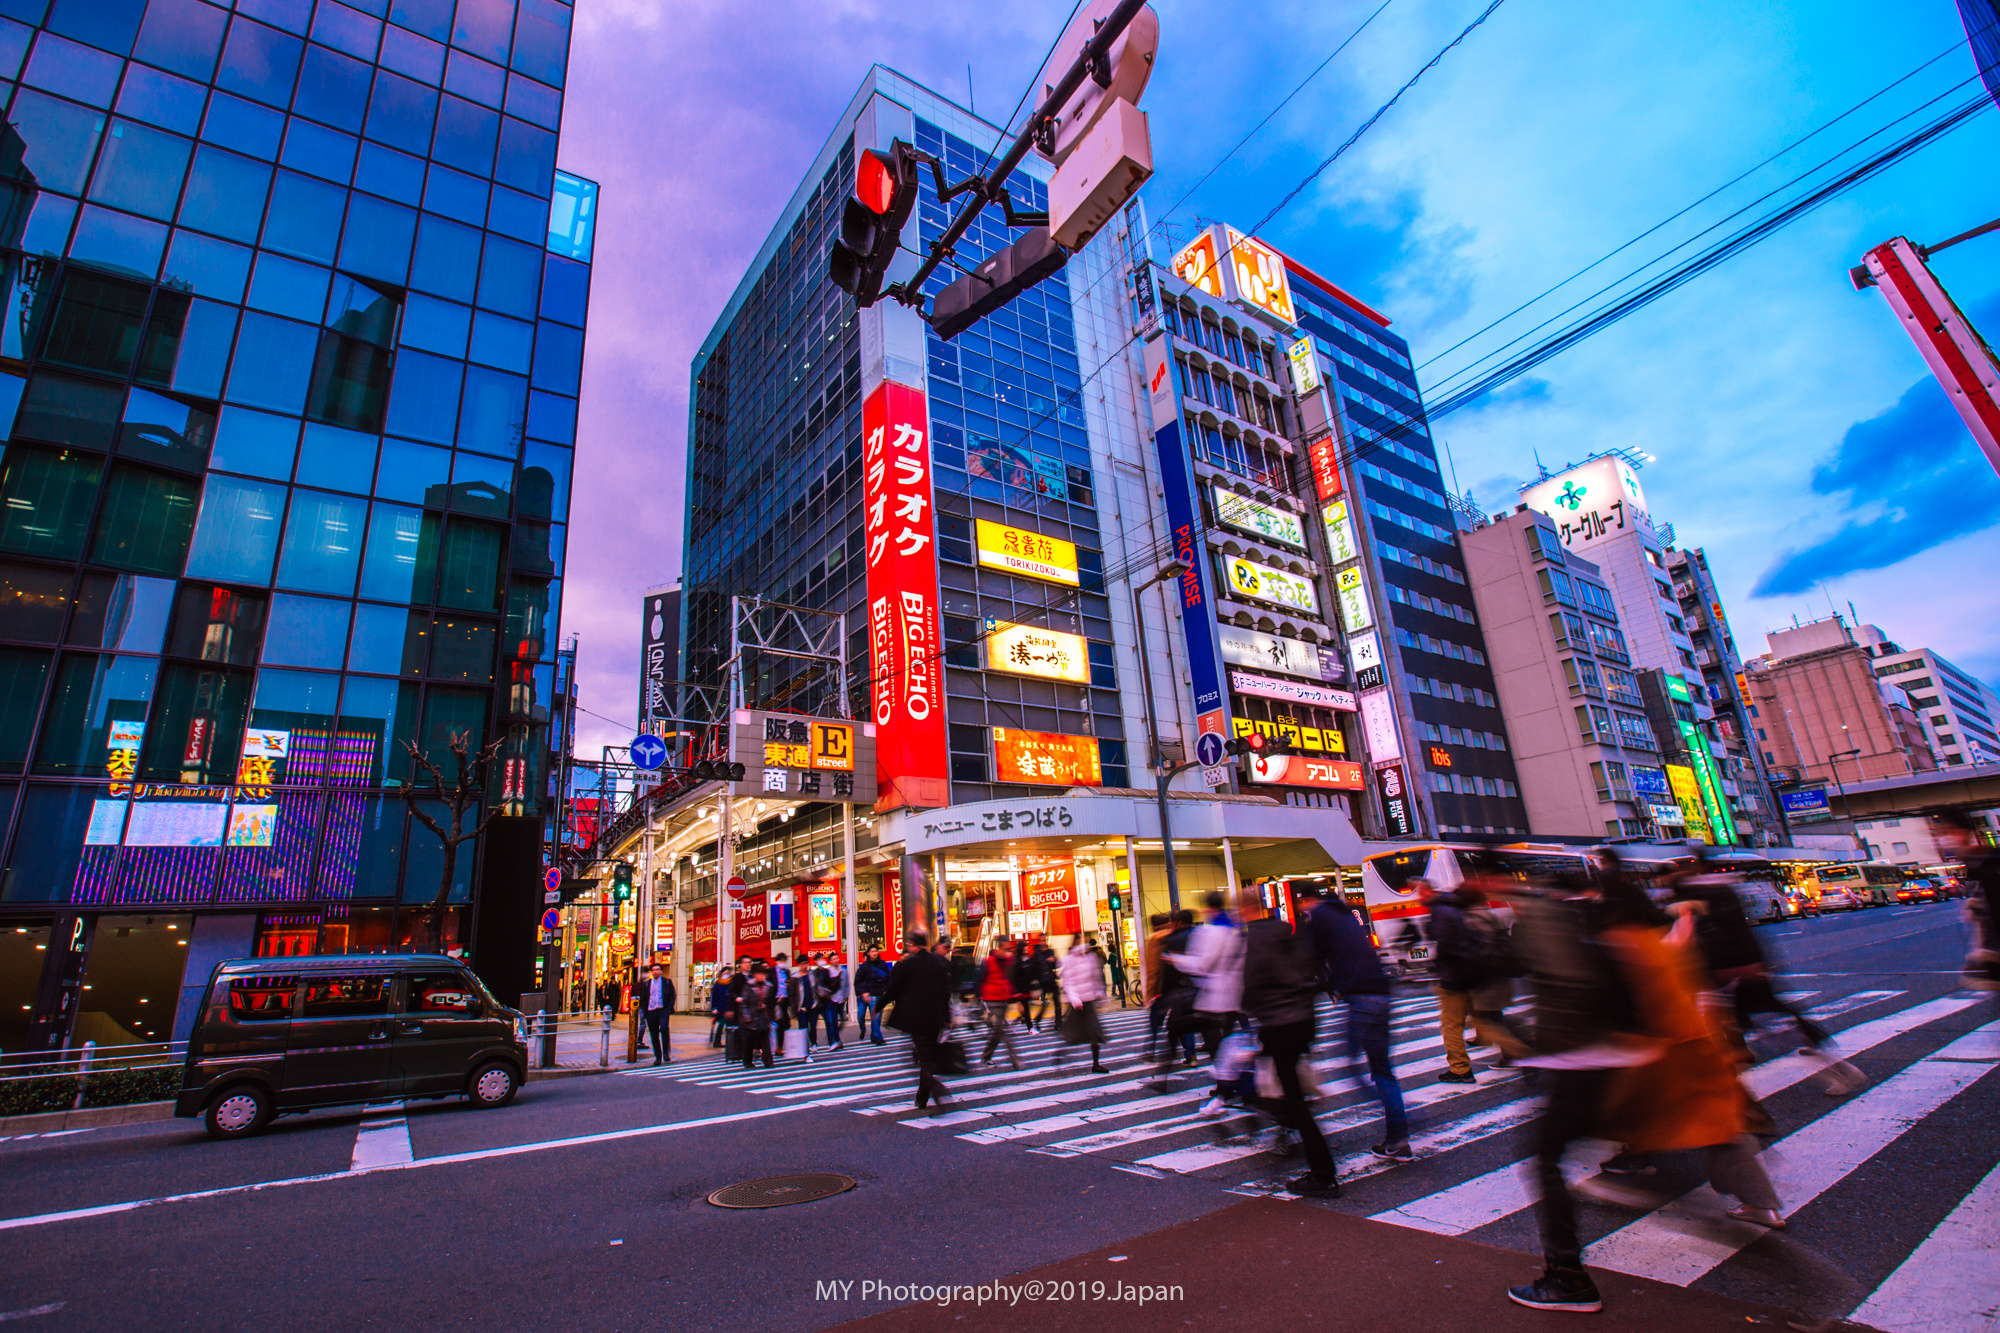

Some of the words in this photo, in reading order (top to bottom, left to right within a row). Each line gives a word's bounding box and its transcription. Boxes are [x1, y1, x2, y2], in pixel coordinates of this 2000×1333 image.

[1319, 456, 1333, 485] アコム
[867, 425, 889, 568] カラオケ
[893, 423, 930, 556] カラオケ
[1326, 487, 1334, 496] 2F
[1004, 531, 1054, 562] 鳥貴族
[1005, 556, 1056, 576] TORIKIZOKU
[1175, 524, 1201, 608] PROMISE
[873, 596, 888, 647] BIG
[901, 591, 925, 641] BIG
[1267, 640, 1290, 669] 刻
[877, 650, 891, 726] ECHO
[908, 646, 929, 720] ECHO
[928, 645, 938, 709] Entertainment
[1233, 676, 1244, 689] 3F
[1246, 678, 1278, 691] ニューハーフ
[1279, 684, 1295, 692] ショー
[1297, 687, 1322, 701] ジャック
[1197, 690, 1219, 704] プロミス
[766, 718, 809, 743] 阪急
[1277, 715, 1299, 725] B2F
[818, 725, 846, 758] E
[994, 729, 1004, 739] 8F
[764, 742, 810, 768] 東通
[817, 757, 848, 768] street
[1431, 747, 1451, 767] ibis
[764, 768, 853, 796] 商店街
[1306, 763, 1341, 782] アコム
[1350, 770, 1361, 781] 2F
[1388, 801, 1398, 818] PUB
[1394, 799, 1408, 833] BRITISH
[924, 820, 976, 839] アベニュー
[981, 806, 1073, 832] こまつばら
[1029, 868, 1066, 887] カラオケ
[1029, 893, 1045, 908] BIG
[1045, 889, 1069, 903] ECHO
[741, 903, 763, 920] カラオケ
[69, 917, 84, 951] P
[611, 937, 631, 946] 180円
[695, 925, 707, 941] BIG
[706, 922, 722, 937] ECH
[740, 926, 752, 940] BIG
[752, 923, 764, 937] ECHO
